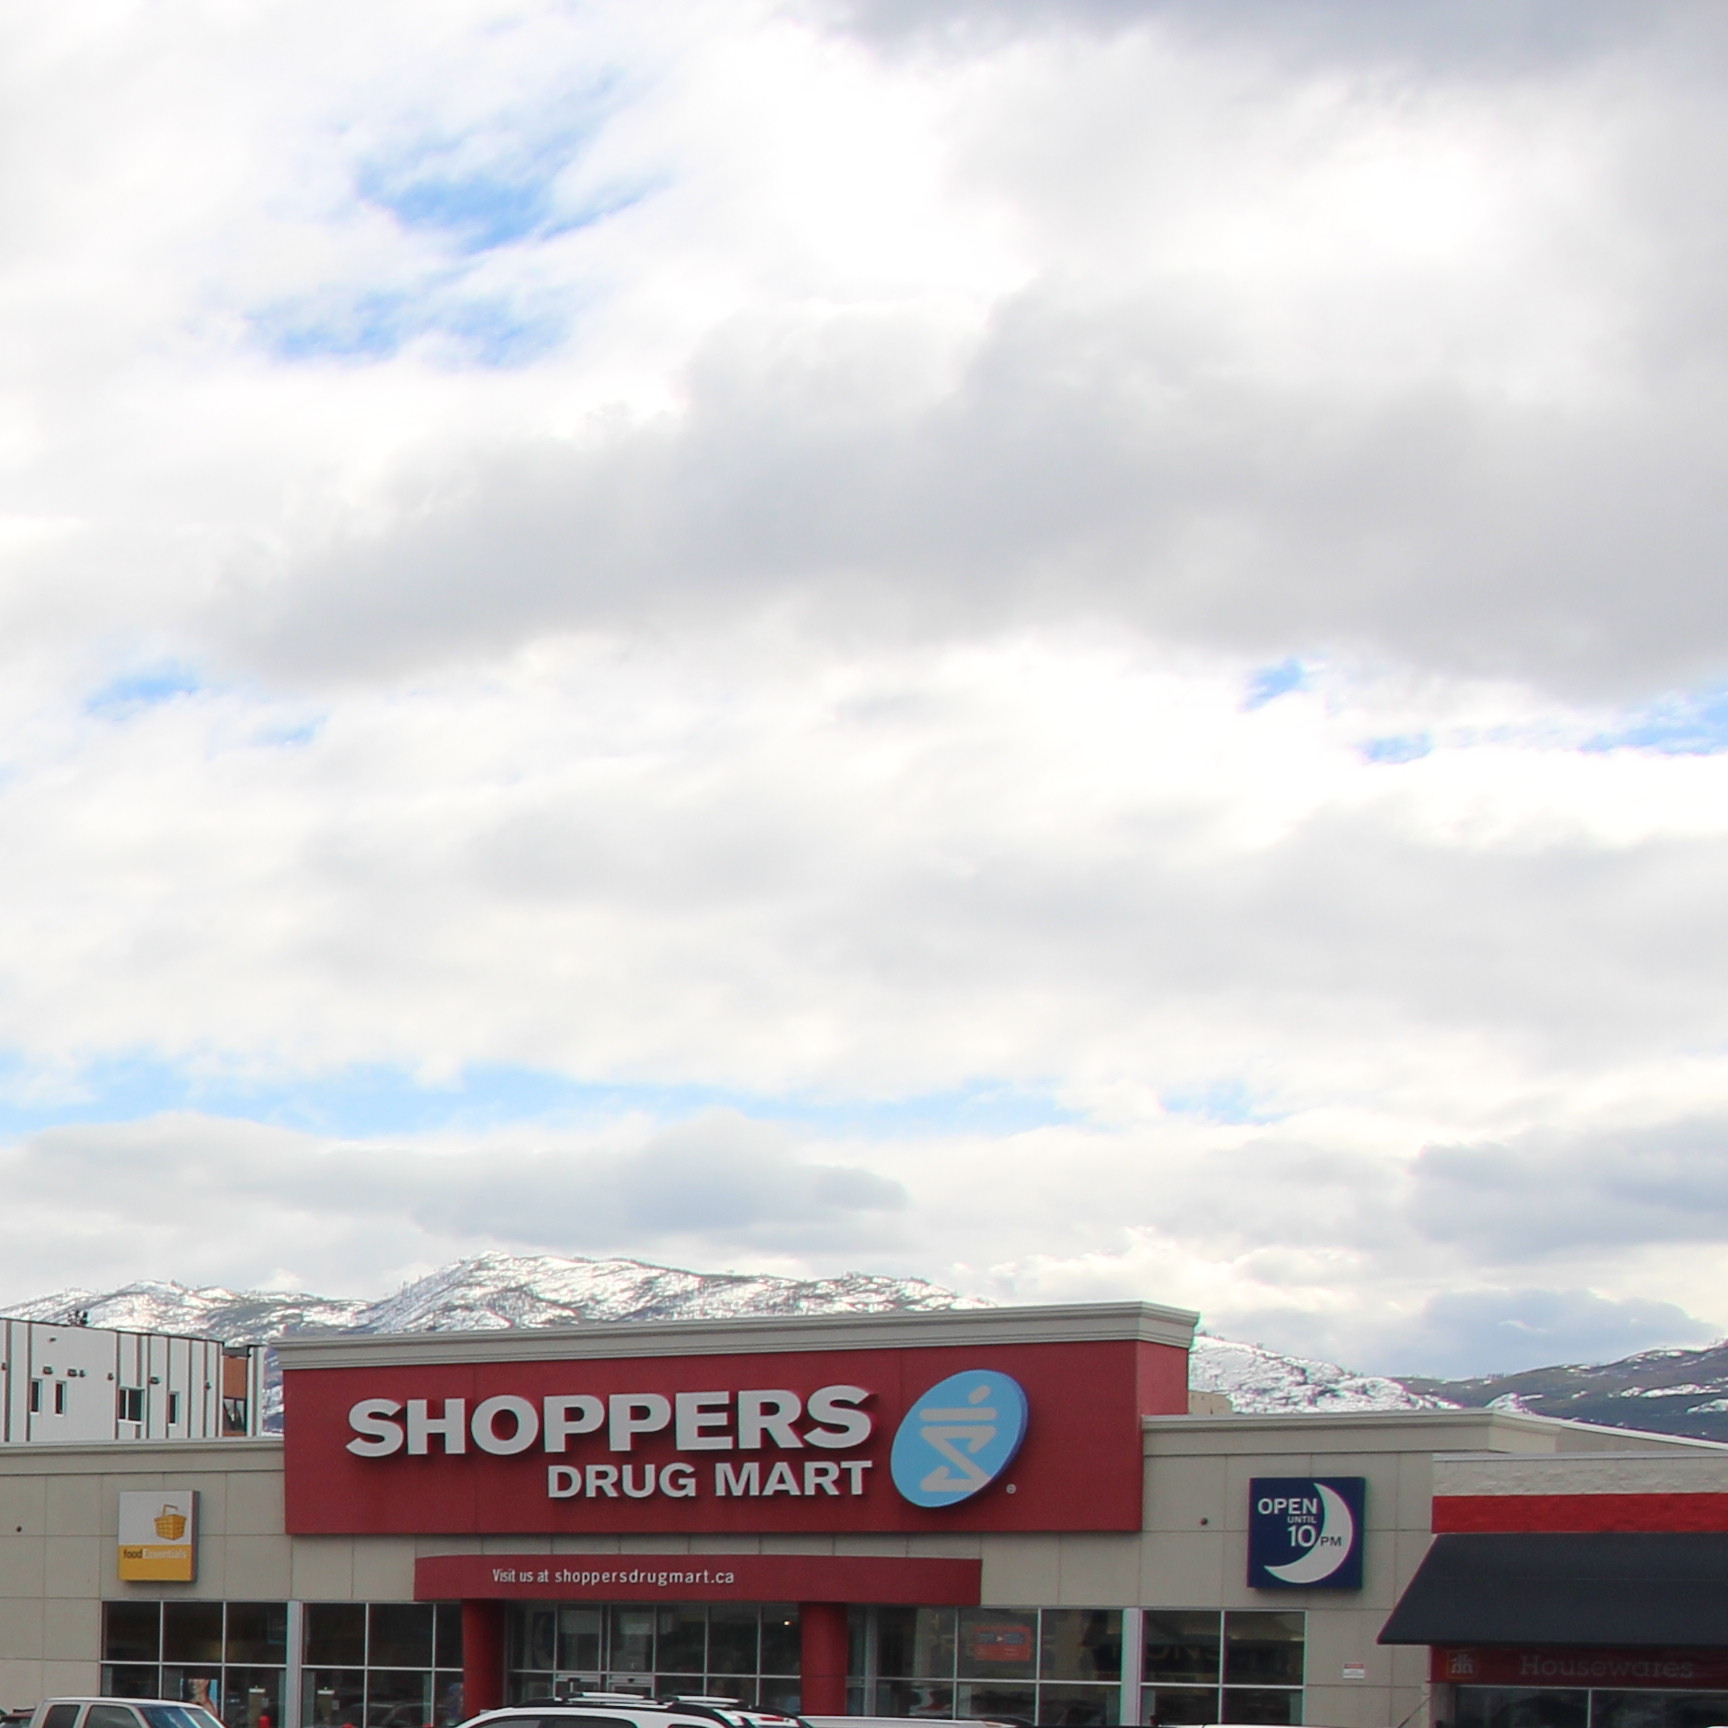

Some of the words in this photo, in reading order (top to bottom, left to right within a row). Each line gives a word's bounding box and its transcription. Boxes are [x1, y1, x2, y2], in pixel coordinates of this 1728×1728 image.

[345, 1384, 873, 1457] SHOPPERS
[547, 1462, 696, 1499] DRUG
[714, 1460, 874, 1497] MART
[1257, 1498, 1318, 1515] OPEN
[1287, 1516, 1317, 1524] UNTIL
[1287, 1525, 1317, 1547] 10
[1320, 1536, 1342, 1547] PM
[493, 1568, 516, 1583] Visit
[519, 1571, 534, 1583] us
[537, 1569, 549, 1583] at
[555, 1569, 735, 1587] shoppersdrugmart.ca
[1520, 1655, 1695, 1678] Housewares
